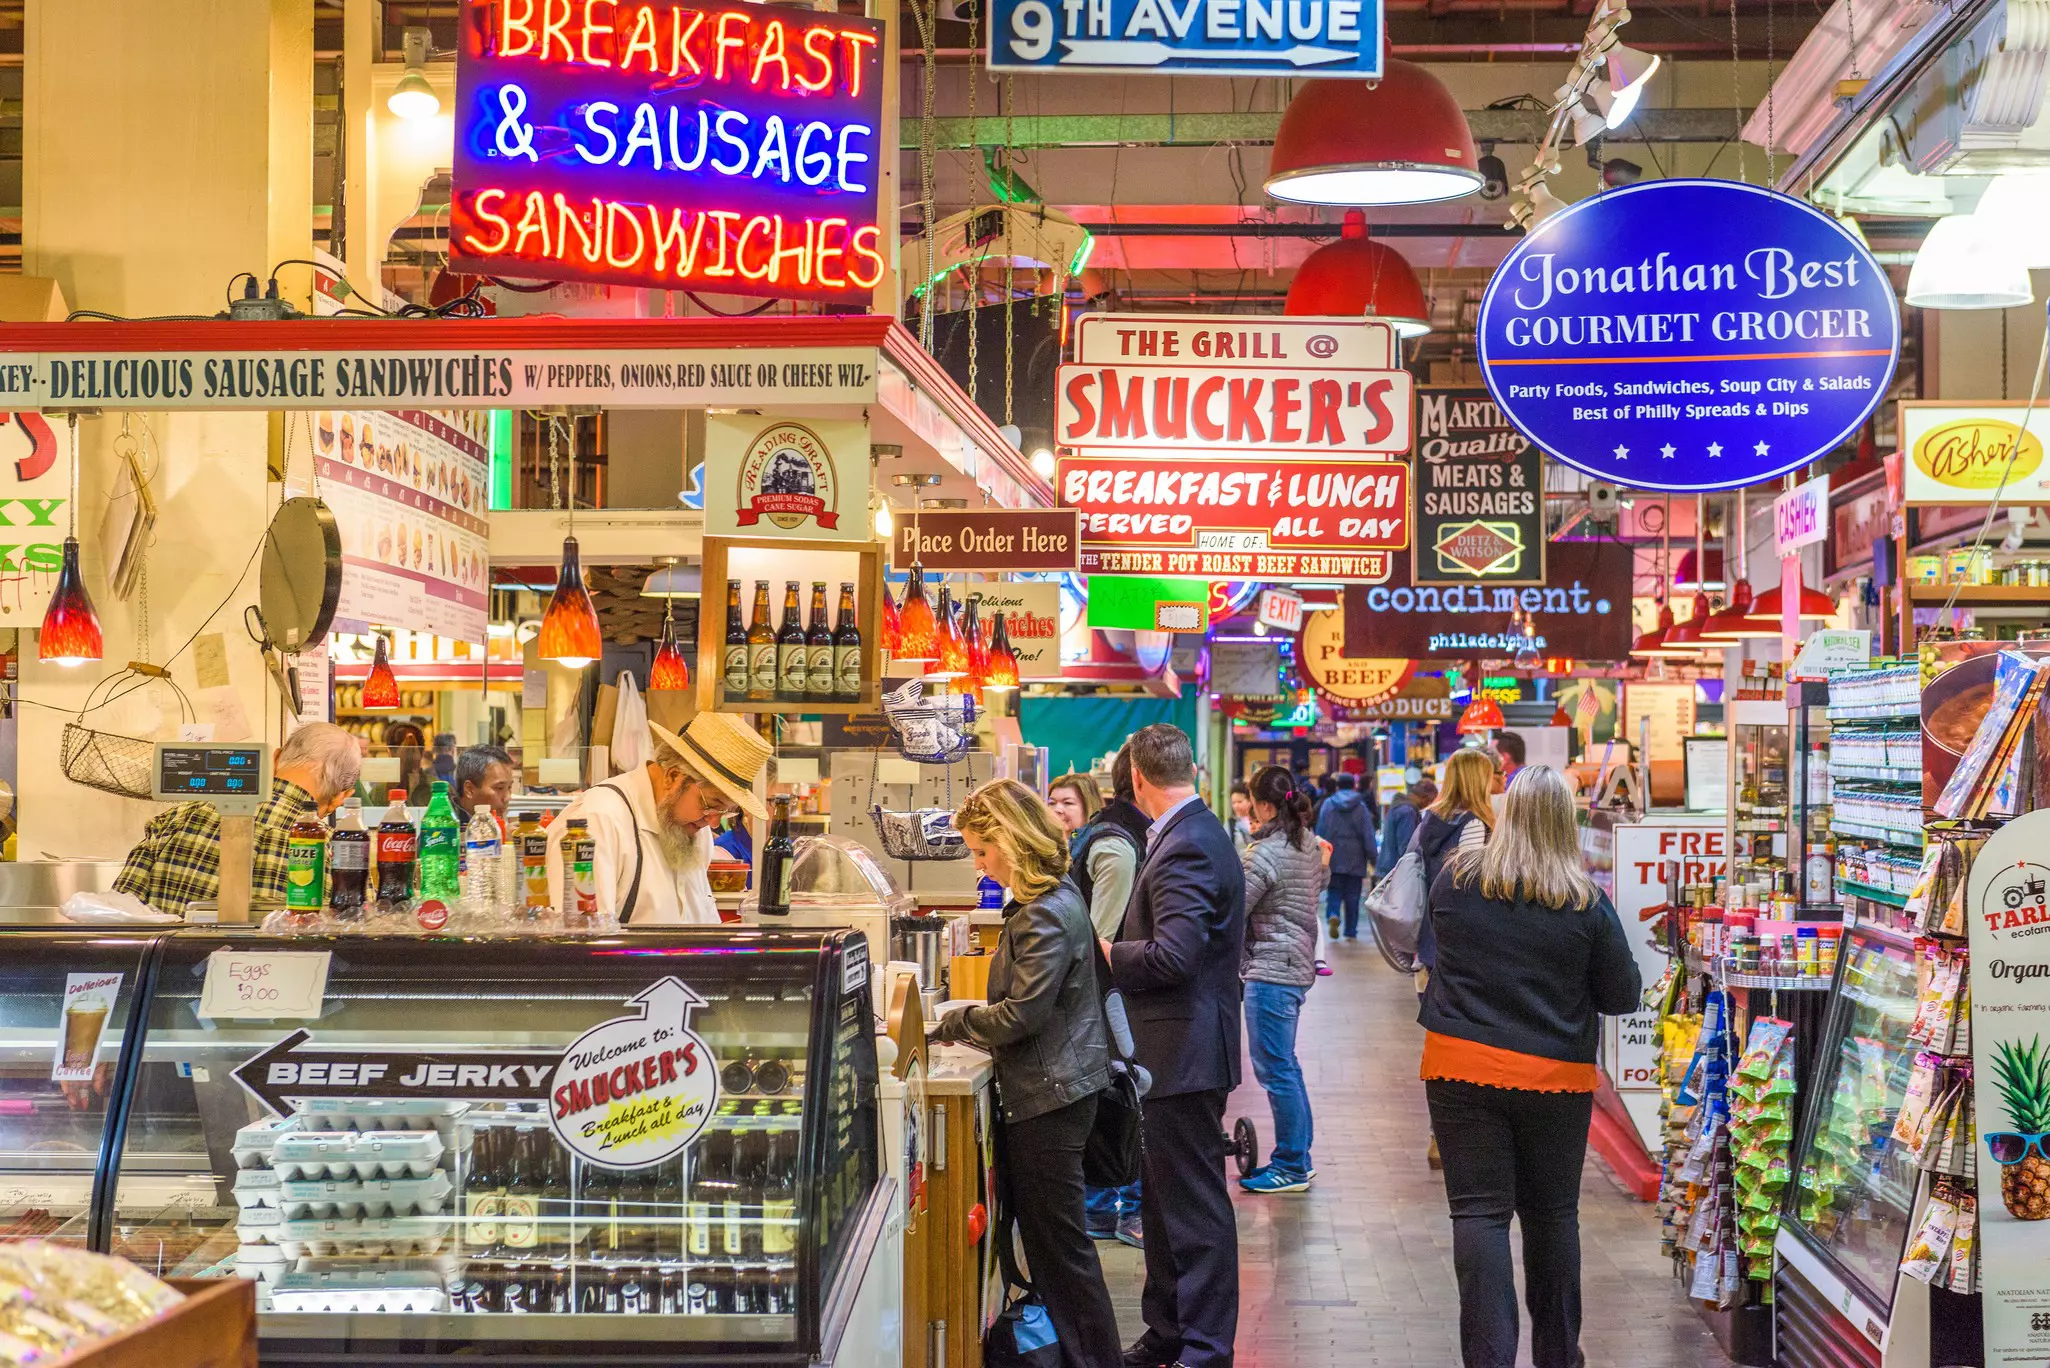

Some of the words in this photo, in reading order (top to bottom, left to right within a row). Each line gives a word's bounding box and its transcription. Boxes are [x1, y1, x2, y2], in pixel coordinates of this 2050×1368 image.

[1009, 0, 1110, 60] 9TH
[1124, 0, 1361, 41] AVENUE
[497, 0, 877, 97] BREAKFAST
[495, 84, 538, 162] &
[574, 101, 871, 193] SAUSAGE
[465, 189, 885, 288] SANDWICHES
[1515, 252, 1737, 310] Jonathan
[1744, 247, 1860, 299] Best
[1505, 313, 1699, 346] GOURMET
[1711, 309, 1871, 341] GROCER
[1117, 330, 1179, 357] THE
[1192, 332, 1288, 359] GRILL
[1306, 334, 1338, 358] @
[50, 360, 192, 398] DELICIOUS
[204, 359, 324, 398] SAUSAGE
[336, 357, 513, 397] SANDWICHES
[525, 365, 543, 390] W/
[548, 364, 615, 390] PEPPERS,
[711, 364, 751, 387] SAUCE
[758, 365, 777, 387] OR
[783, 364, 832, 388] CHEESE
[1509, 384, 1550, 400] Party
[1556, 382, 1608, 398] Foods,
[1614, 379, 1715, 396] Sandwiches,
[1720, 378, 1761, 395] Soup
[1767, 376, 1797, 394] City
[1802, 378, 1813, 390] &
[1819, 375, 1871, 390] Salads
[1066, 369, 1394, 445] SMUCKER'S
[1573, 406, 1608, 421] Best
[1614, 405, 1630, 419] of
[1636, 404, 1681, 420] Philly
[1685, 402, 1752, 419] Spreads
[1756, 403, 1767, 416] &
[1772, 401, 1809, 417] Dips
[745, 433, 796, 491] READING
[799, 436, 828, 491] DRAFT
[1421, 432, 1531, 465] Quality
[1065, 470, 1267, 506] BREAKFAST
[1268, 470, 1283, 508] &
[1287, 475, 1399, 508] LUNCH
[1433, 465, 1502, 487] MEATS
[1509, 465, 1525, 487] &
[756, 495, 792, 504] PREMIUM
[794, 496, 820, 506] SODAS
[764, 503, 786, 511] CANE
[787, 503, 813, 513] SUGAR
[1425, 492, 1535, 515] SAUSAGES
[1080, 514, 1192, 534] SERVED
[1272, 518, 1323, 538] ALL
[1339, 518, 1402, 539] DAY
[1779, 490, 1817, 545] CASHIER
[903, 527, 952, 552] Place
[960, 527, 1014, 552] Order
[1022, 527, 1067, 552] Here
[1200, 535, 1235, 548] HOME
[1242, 537, 1264, 549] OF:
[1450, 547, 1503, 557] WATSON
[1458, 535, 1492, 546] DIETZ
[1494, 535, 1502, 546] &
[1081, 554, 1098, 566] THE
[1101, 554, 1163, 571] TENDER
[1168, 555, 1198, 571] POT
[1201, 556, 1252, 573] ROAST
[1257, 557, 1295, 573] BEEF
[1300, 557, 1381, 576] SANDWICH
[1267, 595, 1297, 623] EXIT
[1367, 583, 1611, 614] condiment.
[1428, 633, 1547, 651] philadelphia
[1324, 670, 1391, 685] BEEF
[229, 962, 271, 980] Eggs
[69, 976, 118, 995] Delicious
[650, 1027, 674, 1045] to:
[568, 1035, 647, 1072] Welcome
[267, 1063, 388, 1085] BEEF
[399, 1063, 554, 1088] JERKY
[555, 1042, 697, 1120] SMUCKER'S
[580, 1099, 660, 1138] Breakfast
[660, 1097, 673, 1108] &
[598, 1123, 649, 1151] Lunch
[650, 1116, 672, 1138] all
[676, 1102, 705, 1127] day
